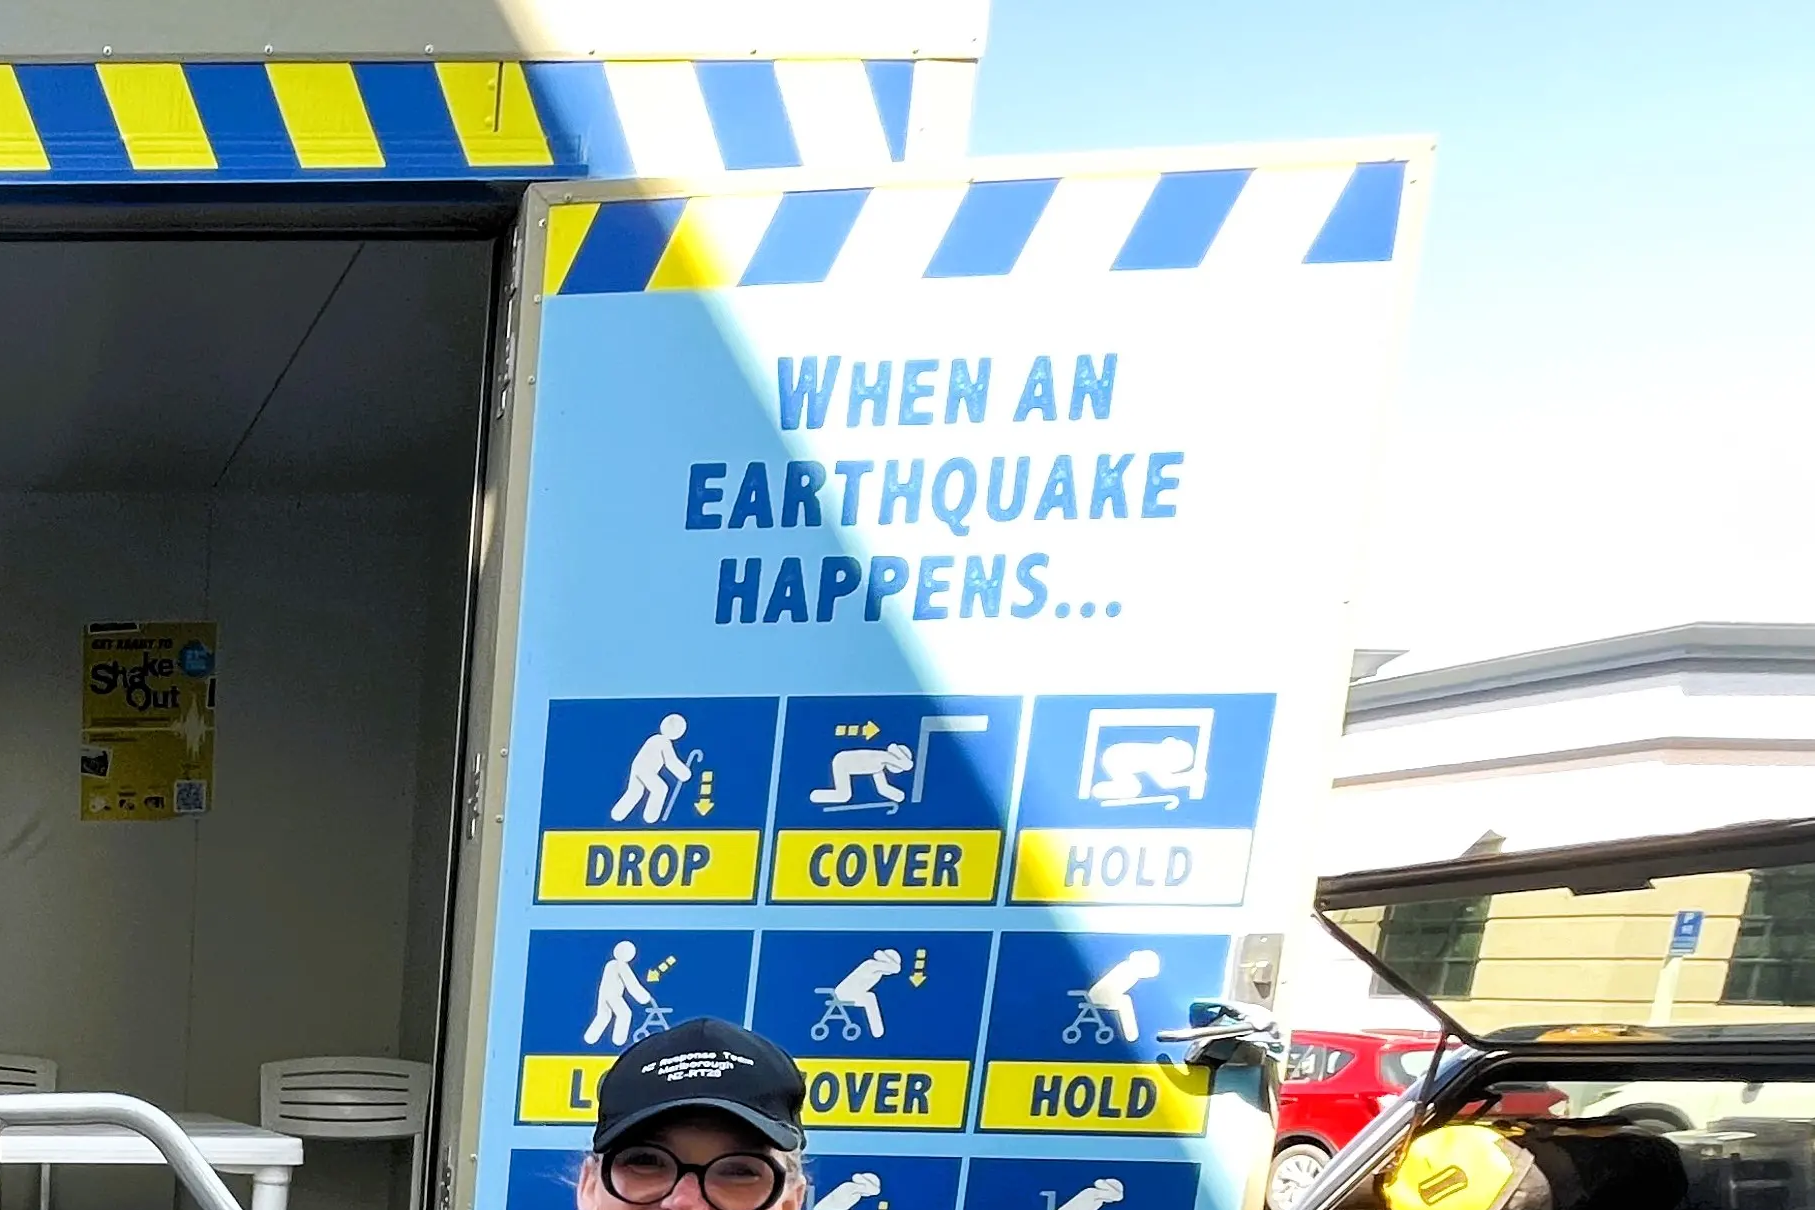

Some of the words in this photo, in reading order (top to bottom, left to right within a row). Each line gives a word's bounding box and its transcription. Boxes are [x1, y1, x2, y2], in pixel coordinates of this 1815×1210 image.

[777, 354, 991, 431] WHEN
[1013, 352, 1119, 421] AN
[685, 451, 1186, 536] EARTHQUAKE
[715, 551, 1122, 625] HAPPENS...
[91, 652, 174, 694] Shake
[126, 686, 180, 711] Out
[586, 843, 712, 887] DROP
[809, 843, 963, 888] COVER
[1063, 845, 1194, 888] HOLD
[658, 1061, 735, 1075] Marlborough
[723, 1052, 754, 1066] Team
[805, 1070, 933, 1114] OVER
[1030, 1073, 1158, 1118] HOLD
